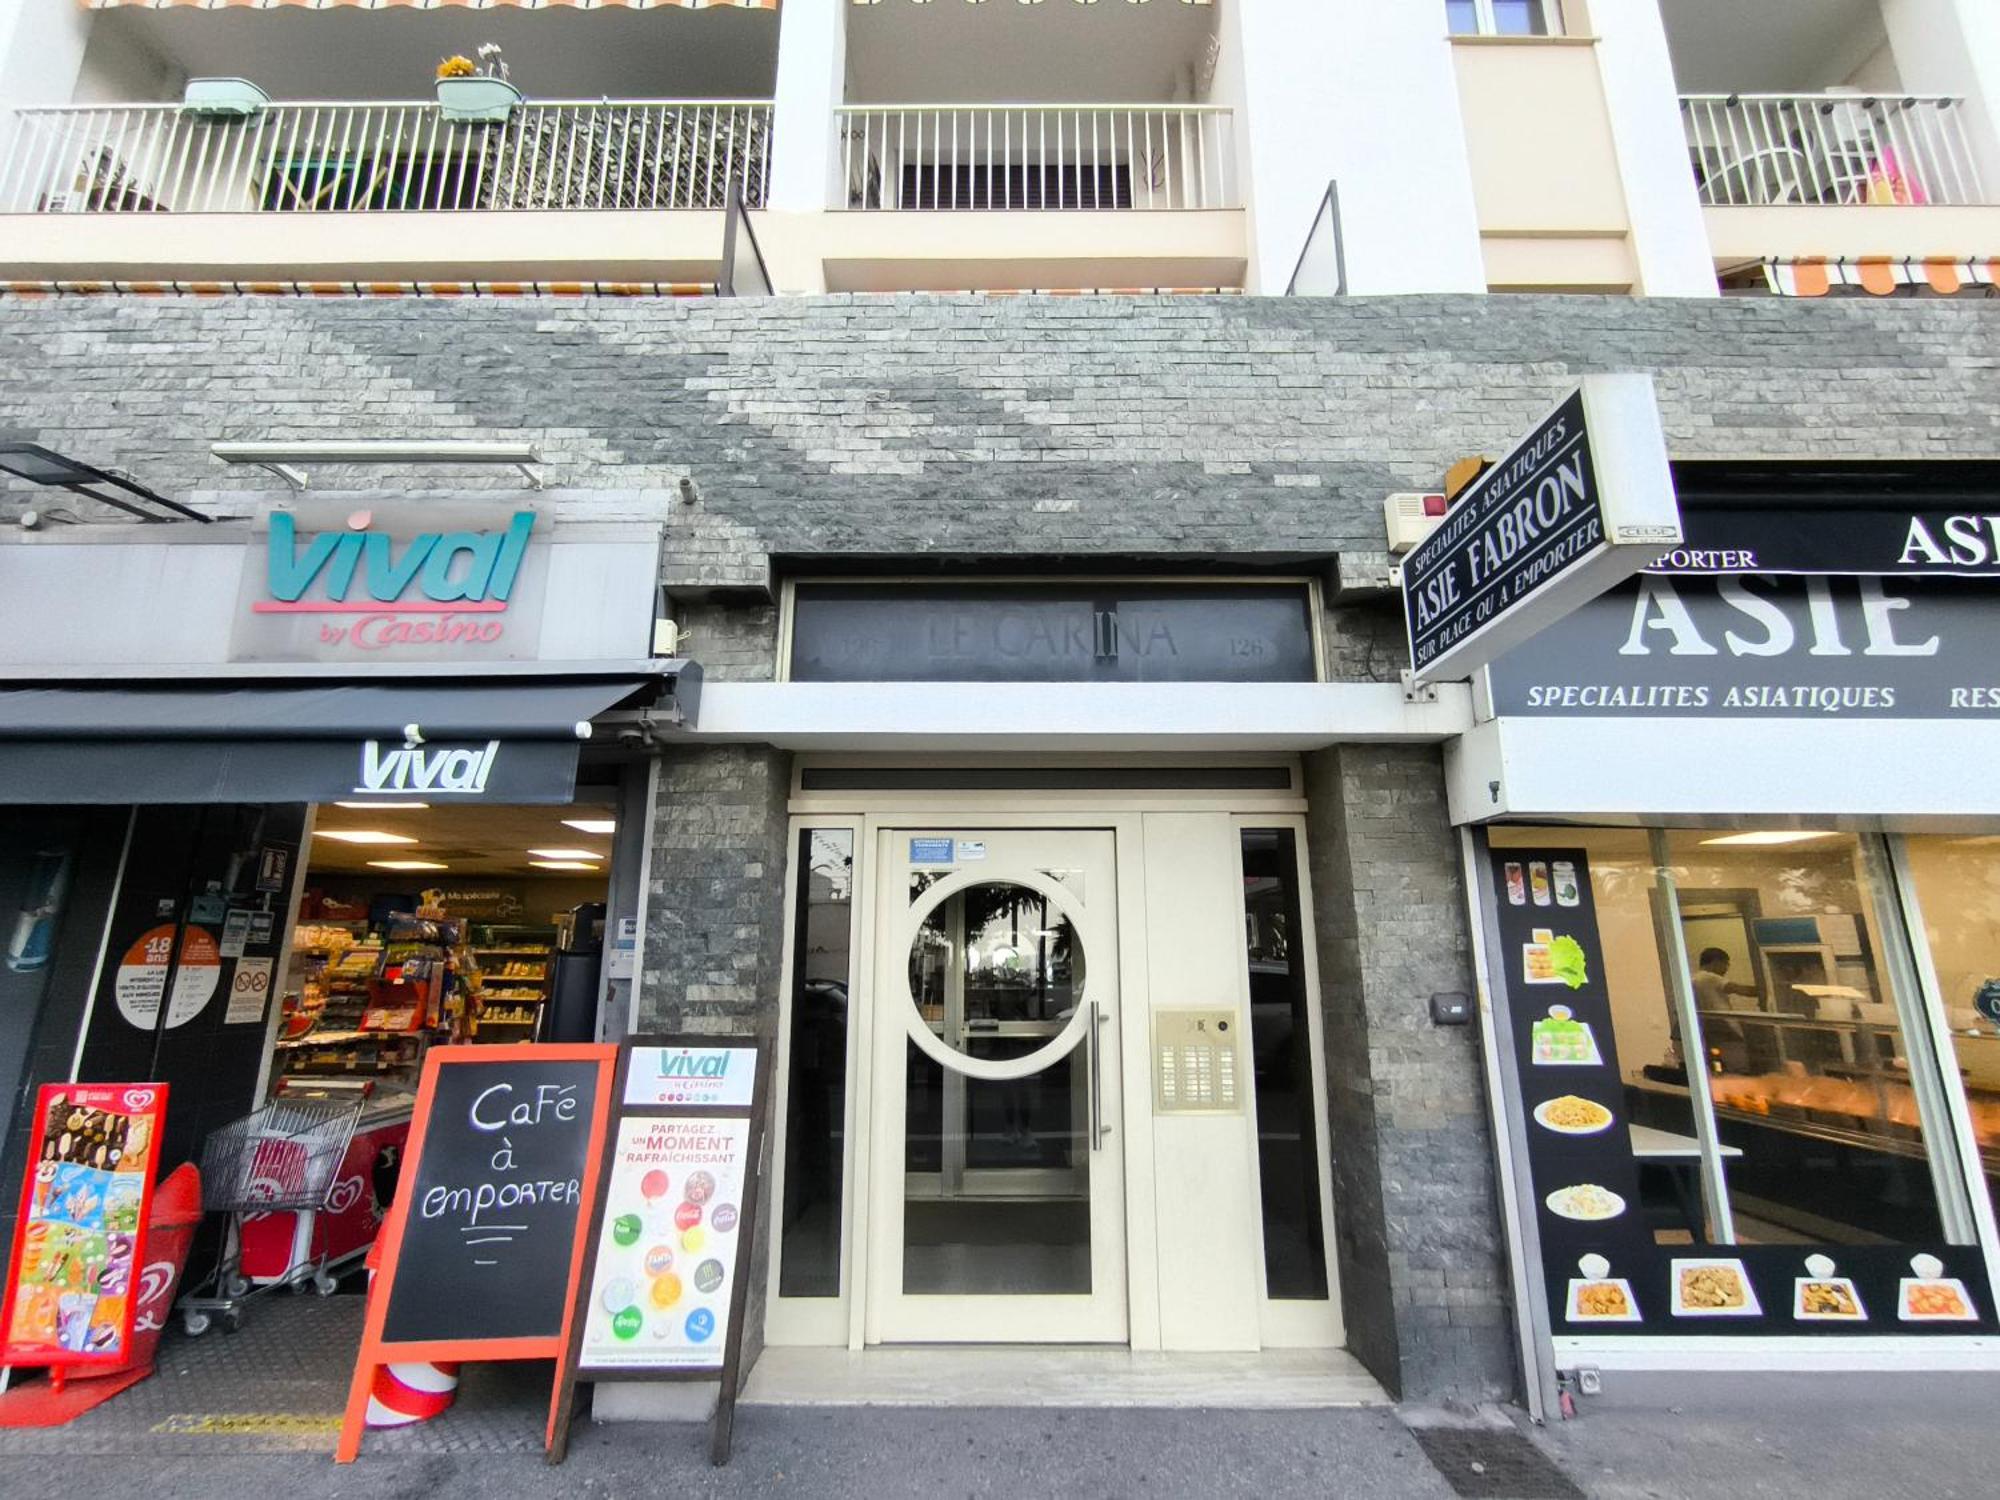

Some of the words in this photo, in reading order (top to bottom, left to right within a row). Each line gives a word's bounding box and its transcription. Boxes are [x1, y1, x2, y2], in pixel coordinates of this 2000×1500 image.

[1415, 502, 1477, 576] SPECIALITES
[1482, 417, 1566, 512] ASIATIQUES
[1417, 561, 1460, 631] ASIE
[1466, 449, 1586, 588] FABRON
[1417, 640, 1436, 664] SUR
[1440, 611, 1472, 649] PLACE
[1476, 594, 1494, 621] OU
[1499, 585, 1508, 607] A
[1515, 517, 1600, 595] EMPORTER
[320, 622, 349, 646] by
[351, 612, 504, 650] Casino
[1618, 573, 1940, 657] ASIE
[928, 613, 976, 656] LE
[993, 610, 1179, 657] CARINA
[1229, 638, 1263, 656] 126
[1527, 685, 1709, 708] SPECIALITES
[1722, 686, 1895, 711] ASIATIQUES
[144, 937, 172, 954] -18
[646, 1136, 734, 1151] MOMENT
[651, 1124, 715, 1135] PARTAGEZ
[491, 1137, 519, 1171] à
